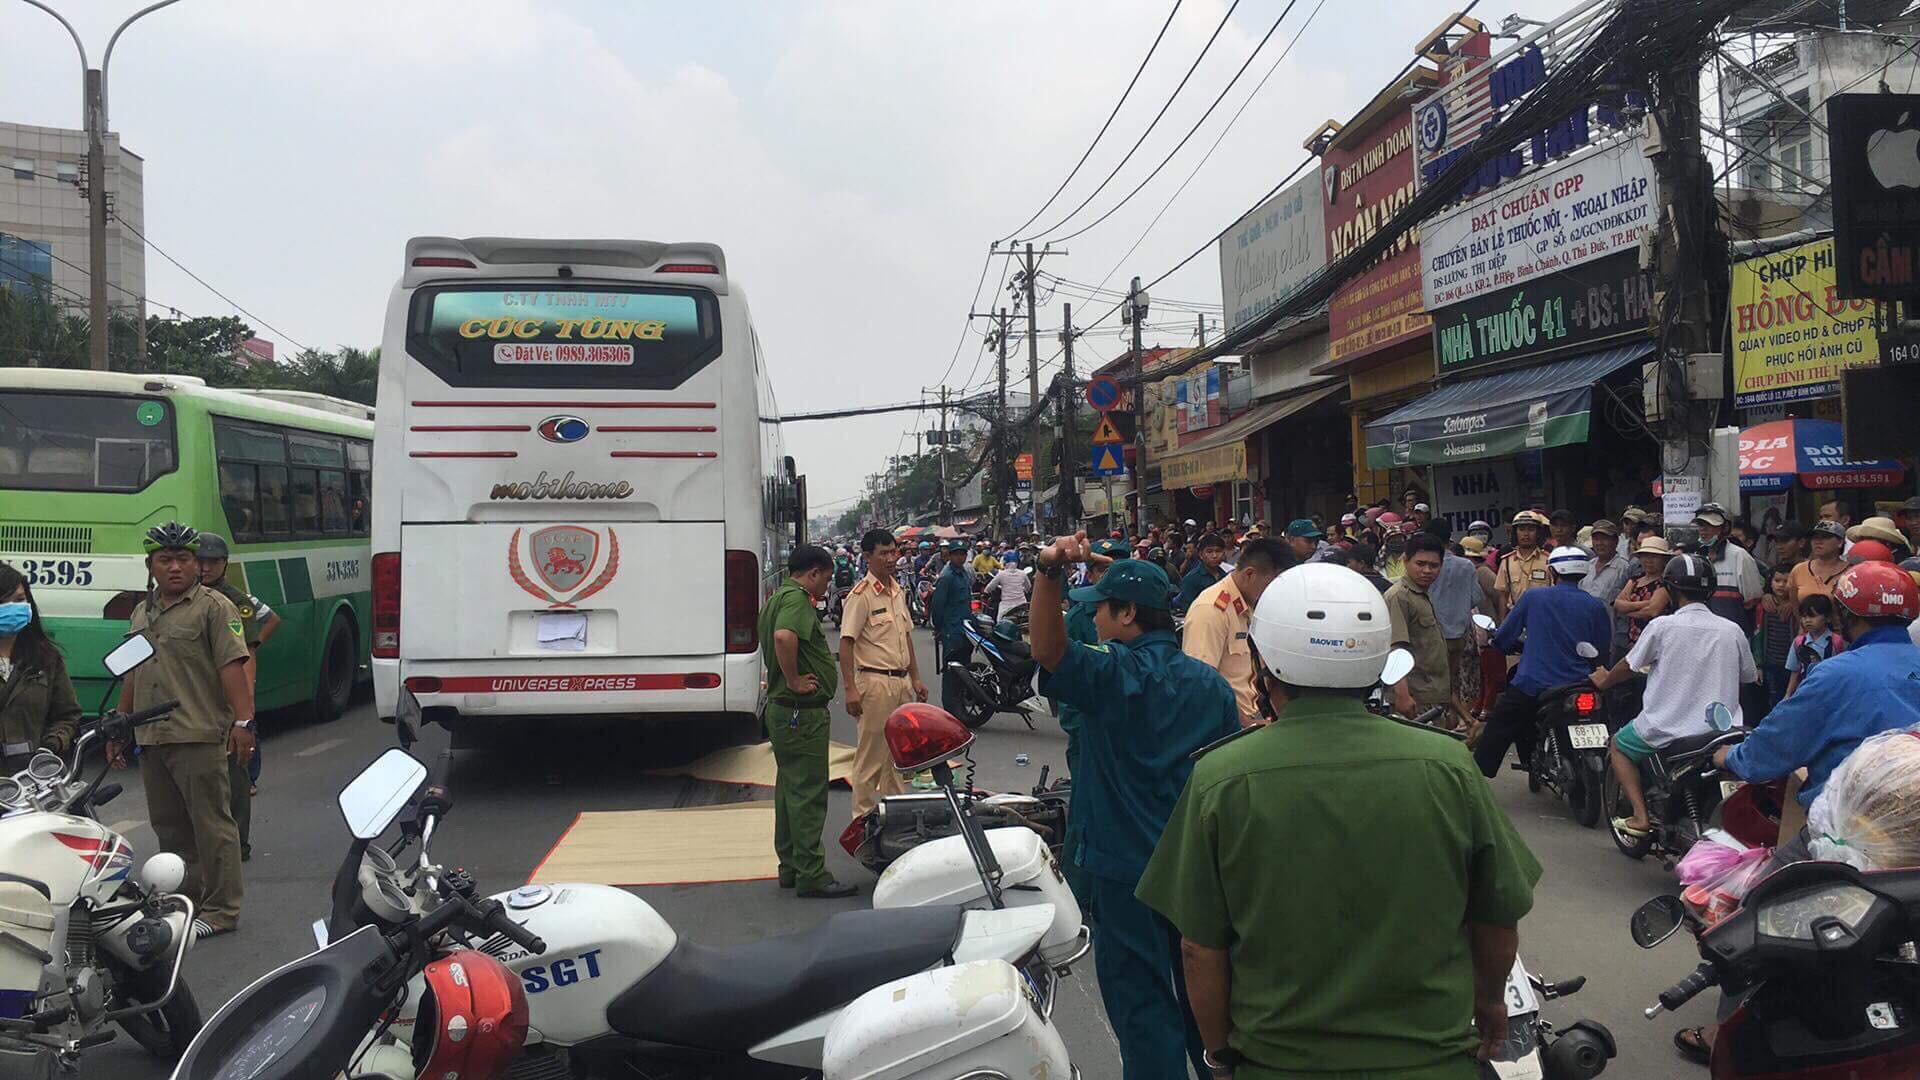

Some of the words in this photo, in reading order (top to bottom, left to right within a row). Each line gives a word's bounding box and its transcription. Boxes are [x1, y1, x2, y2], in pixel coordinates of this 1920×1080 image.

[1363, 143, 1384, 175] KINH
[1471, 208, 1497, 233] ĐẠT
[1501, 183, 1550, 222] CHUẨN
[1554, 174, 1584, 199] GPP
[1432, 246, 1469, 272] CHUYÊN
[1470, 235, 1489, 257] BÁN
[1507, 213, 1541, 245] THUỐC
[1542, 208, 1561, 233] NỘI
[1572, 193, 1608, 221] NGOẠI
[1611, 177, 1648, 208] NHẬP
[1472, 259, 1486, 278] THỊ
[1488, 252, 1507, 275] DIỆP
[1536, 239, 1549, 255] GP
[1573, 243, 1588, 259] Thủ
[1759, 254, 1807, 284] CHỤP
[503, 293, 538, 306] C.TY
[545, 293, 591, 307] TNHH
[596, 293, 630, 308] MTV
[1736, 284, 1815, 334] HỒNG
[459, 316, 545, 340] CÚC
[555, 315, 668, 341] TÙNG
[1440, 313, 1474, 365] NHÀ
[1476, 291, 1536, 356] THUỐC
[1541, 296, 1567, 339] 41
[1738, 337, 1766, 352] QUAY
[1769, 330, 1801, 346] VIDEO
[1803, 327, 1818, 340] HD
[1821, 325, 1829, 337] &
[1832, 319, 1865, 336] CHỤP
[556, 345, 631, 362] 0989.305305
[1766, 352, 1794, 368] PHỤC
[1846, 338, 1863, 353] CŨ
[1890, 346, 1907, 362] 164
[1776, 366, 1804, 384] HÌNH
[1443, 413, 1487, 434] Salonpas
[490, 471, 635, 500] mobihome
[1452, 468, 1500, 497] NHÀ
[23, 560, 94, 586] 3595
[1310, 637, 1344, 647] BAOVIET
[520, 950, 602, 994] SGT
